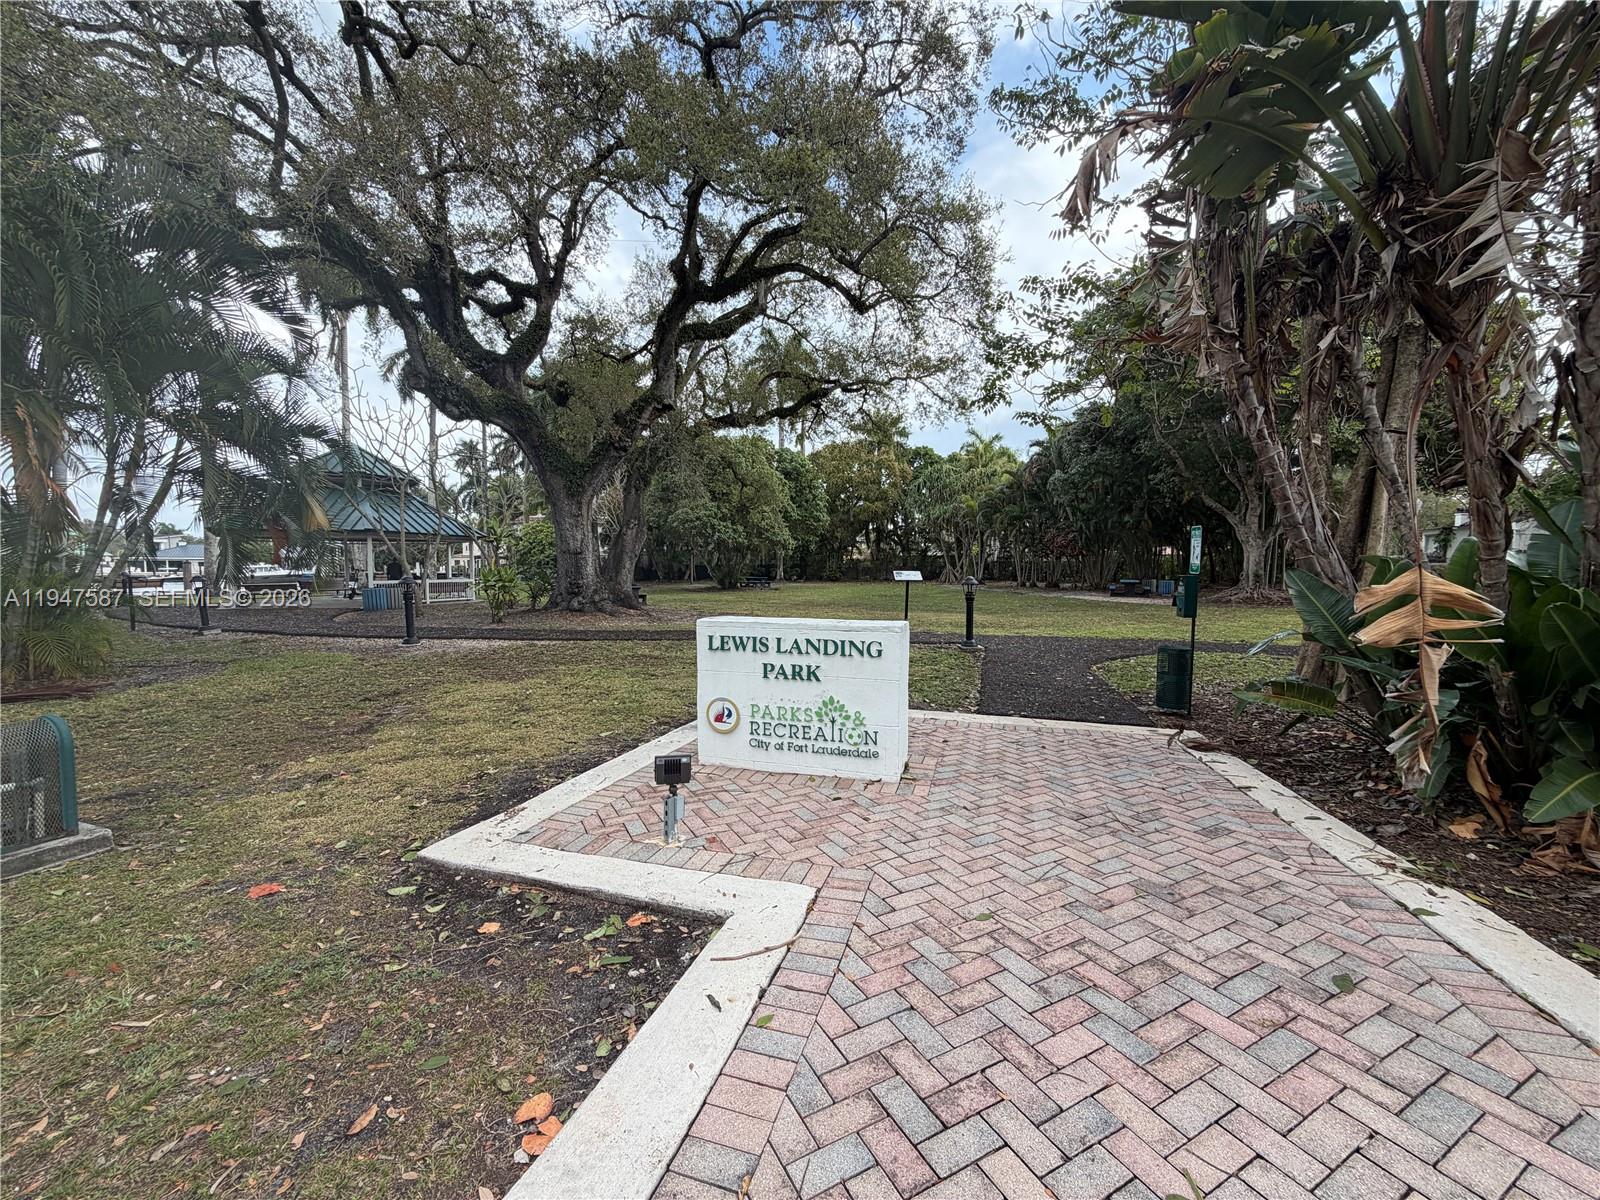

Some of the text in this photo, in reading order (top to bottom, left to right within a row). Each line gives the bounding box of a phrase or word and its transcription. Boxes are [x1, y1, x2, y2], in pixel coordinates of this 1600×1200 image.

[707, 634, 883, 658] LEWIS LANDING
[761, 662, 822, 682] PARK
[750, 703, 814, 723] PARKS
[749, 738, 880, 759] City of Fort Lauderdale
